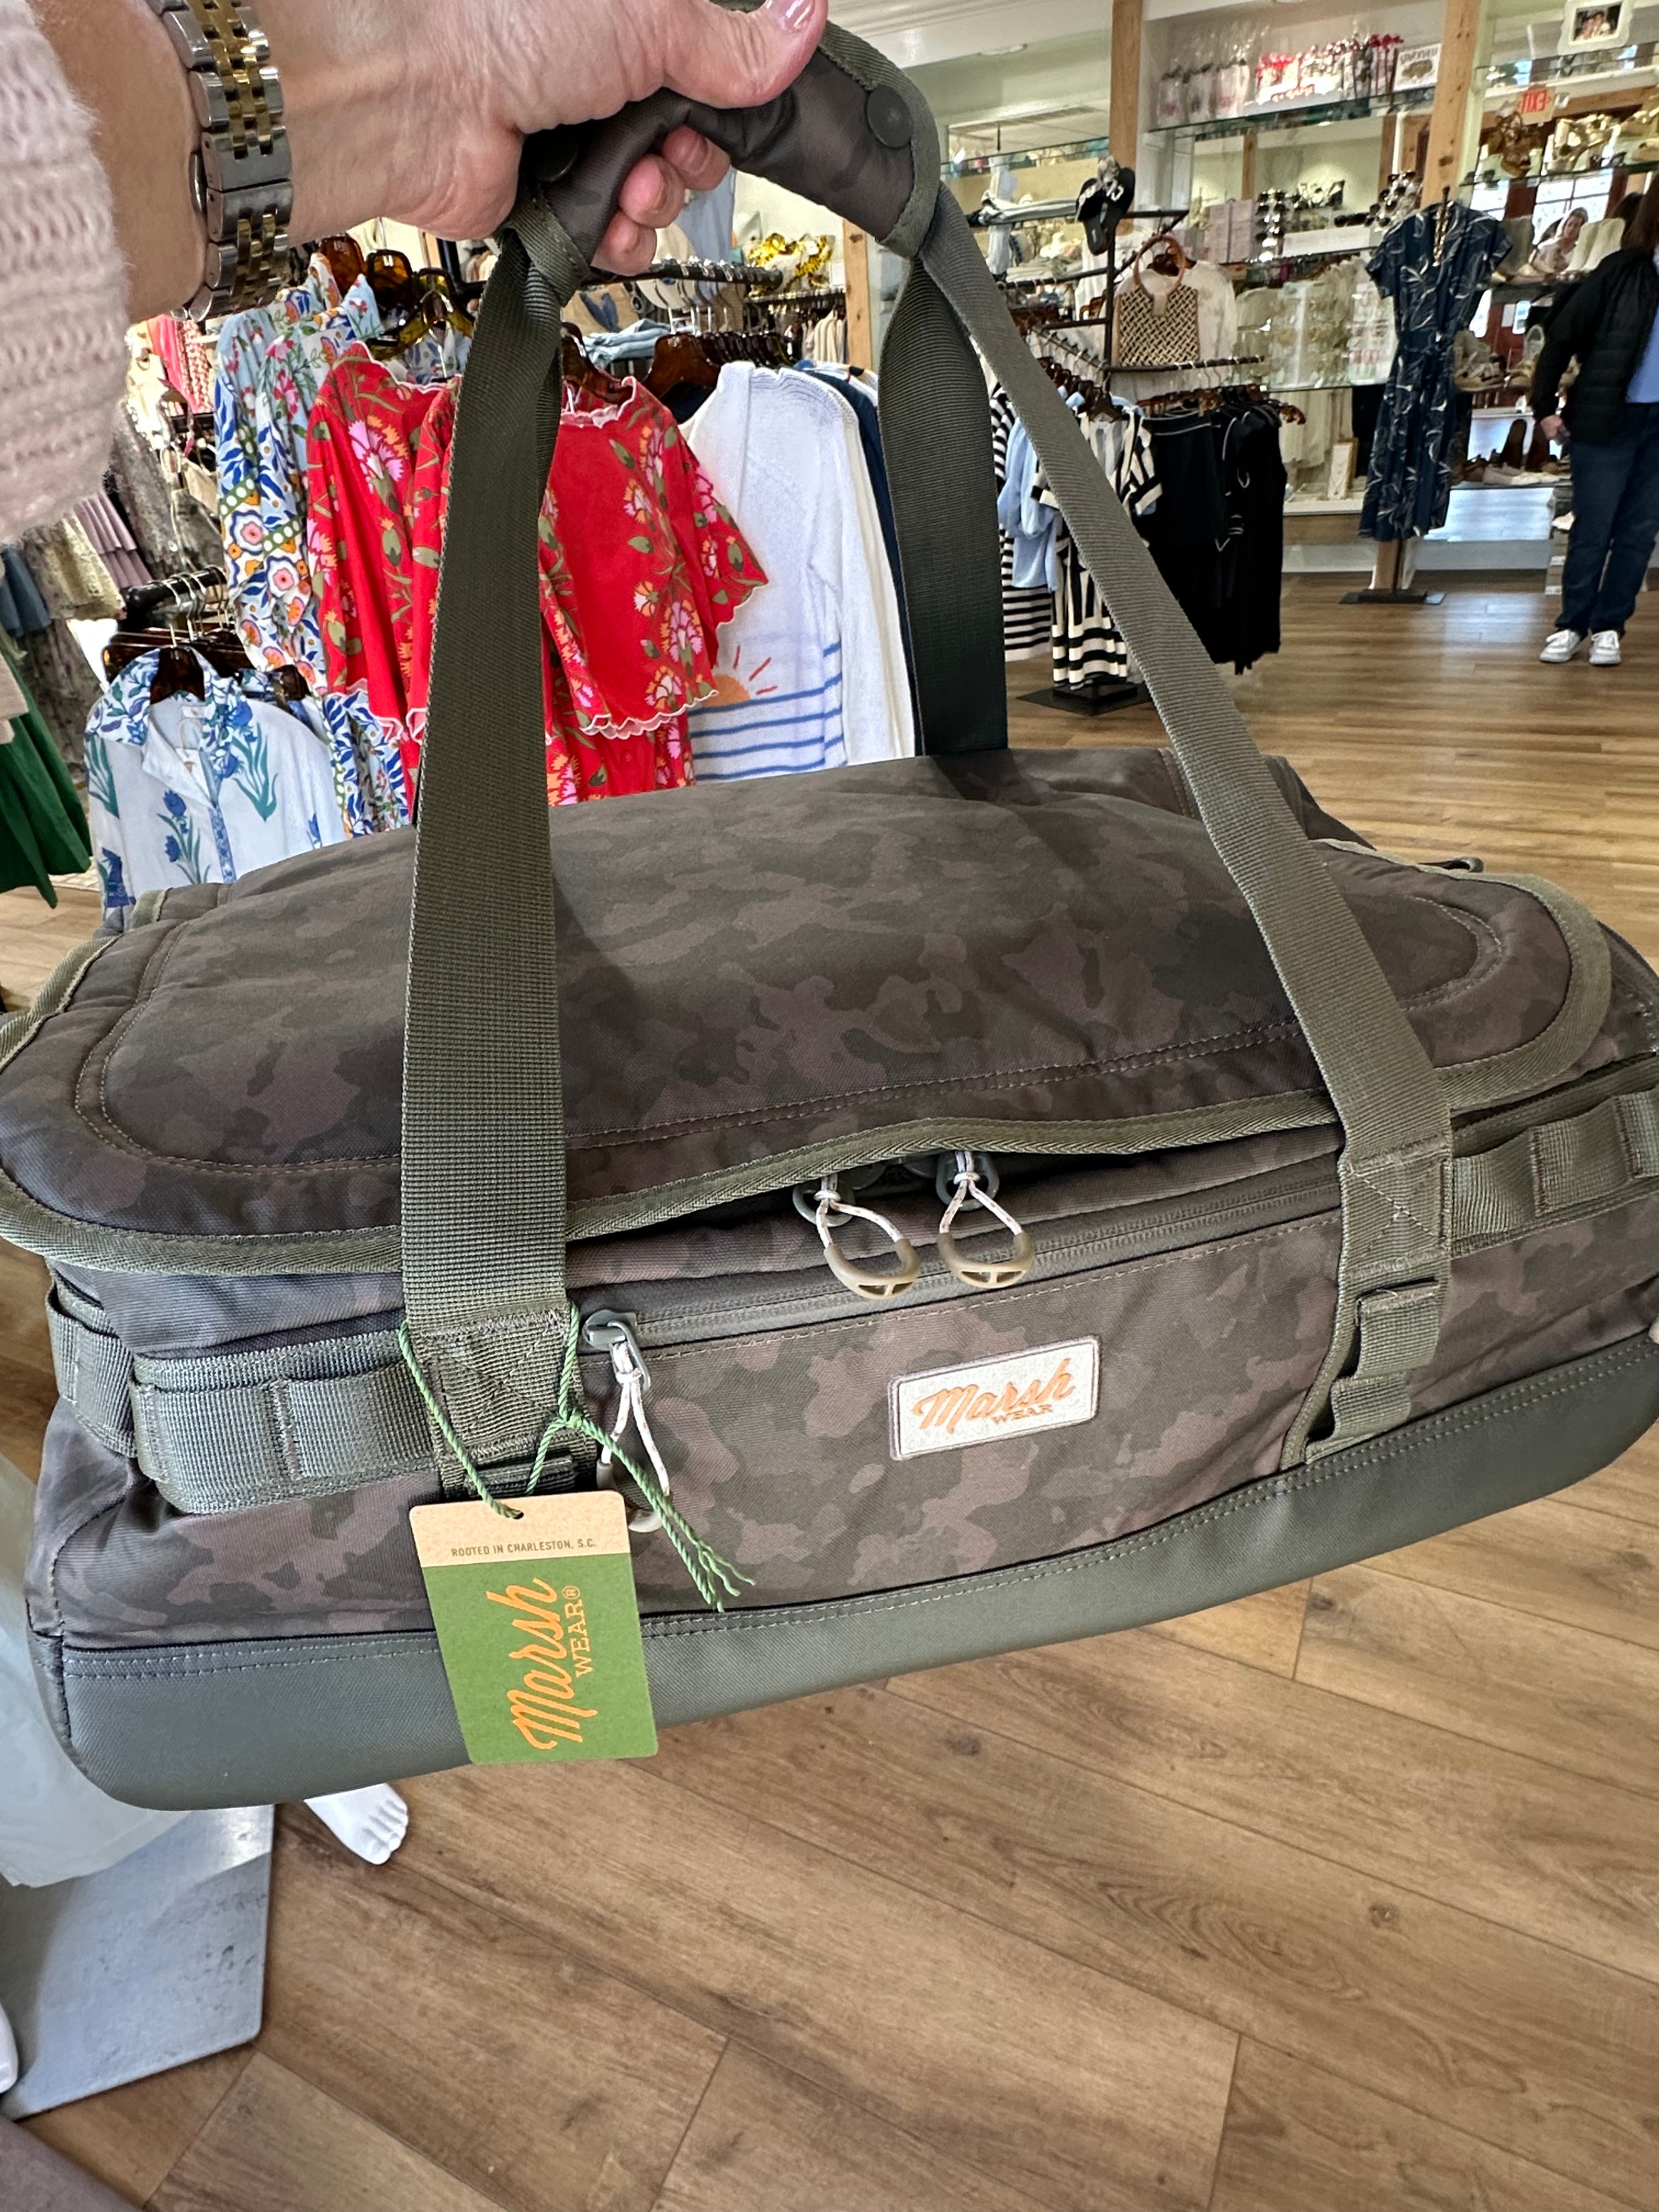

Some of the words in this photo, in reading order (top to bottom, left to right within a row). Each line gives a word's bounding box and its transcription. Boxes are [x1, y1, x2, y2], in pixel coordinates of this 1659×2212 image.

[913, 1358, 1075, 1435] Marsh
[992, 1404, 1053, 1425] WEAR
[452, 1546, 489, 1556] ROOTED
[493, 1544, 504, 1554] IN
[507, 1539, 574, 1553] CHARLESTON,
[578, 1538, 597, 1548] S.C.
[486, 1577, 598, 1750] Marsh
